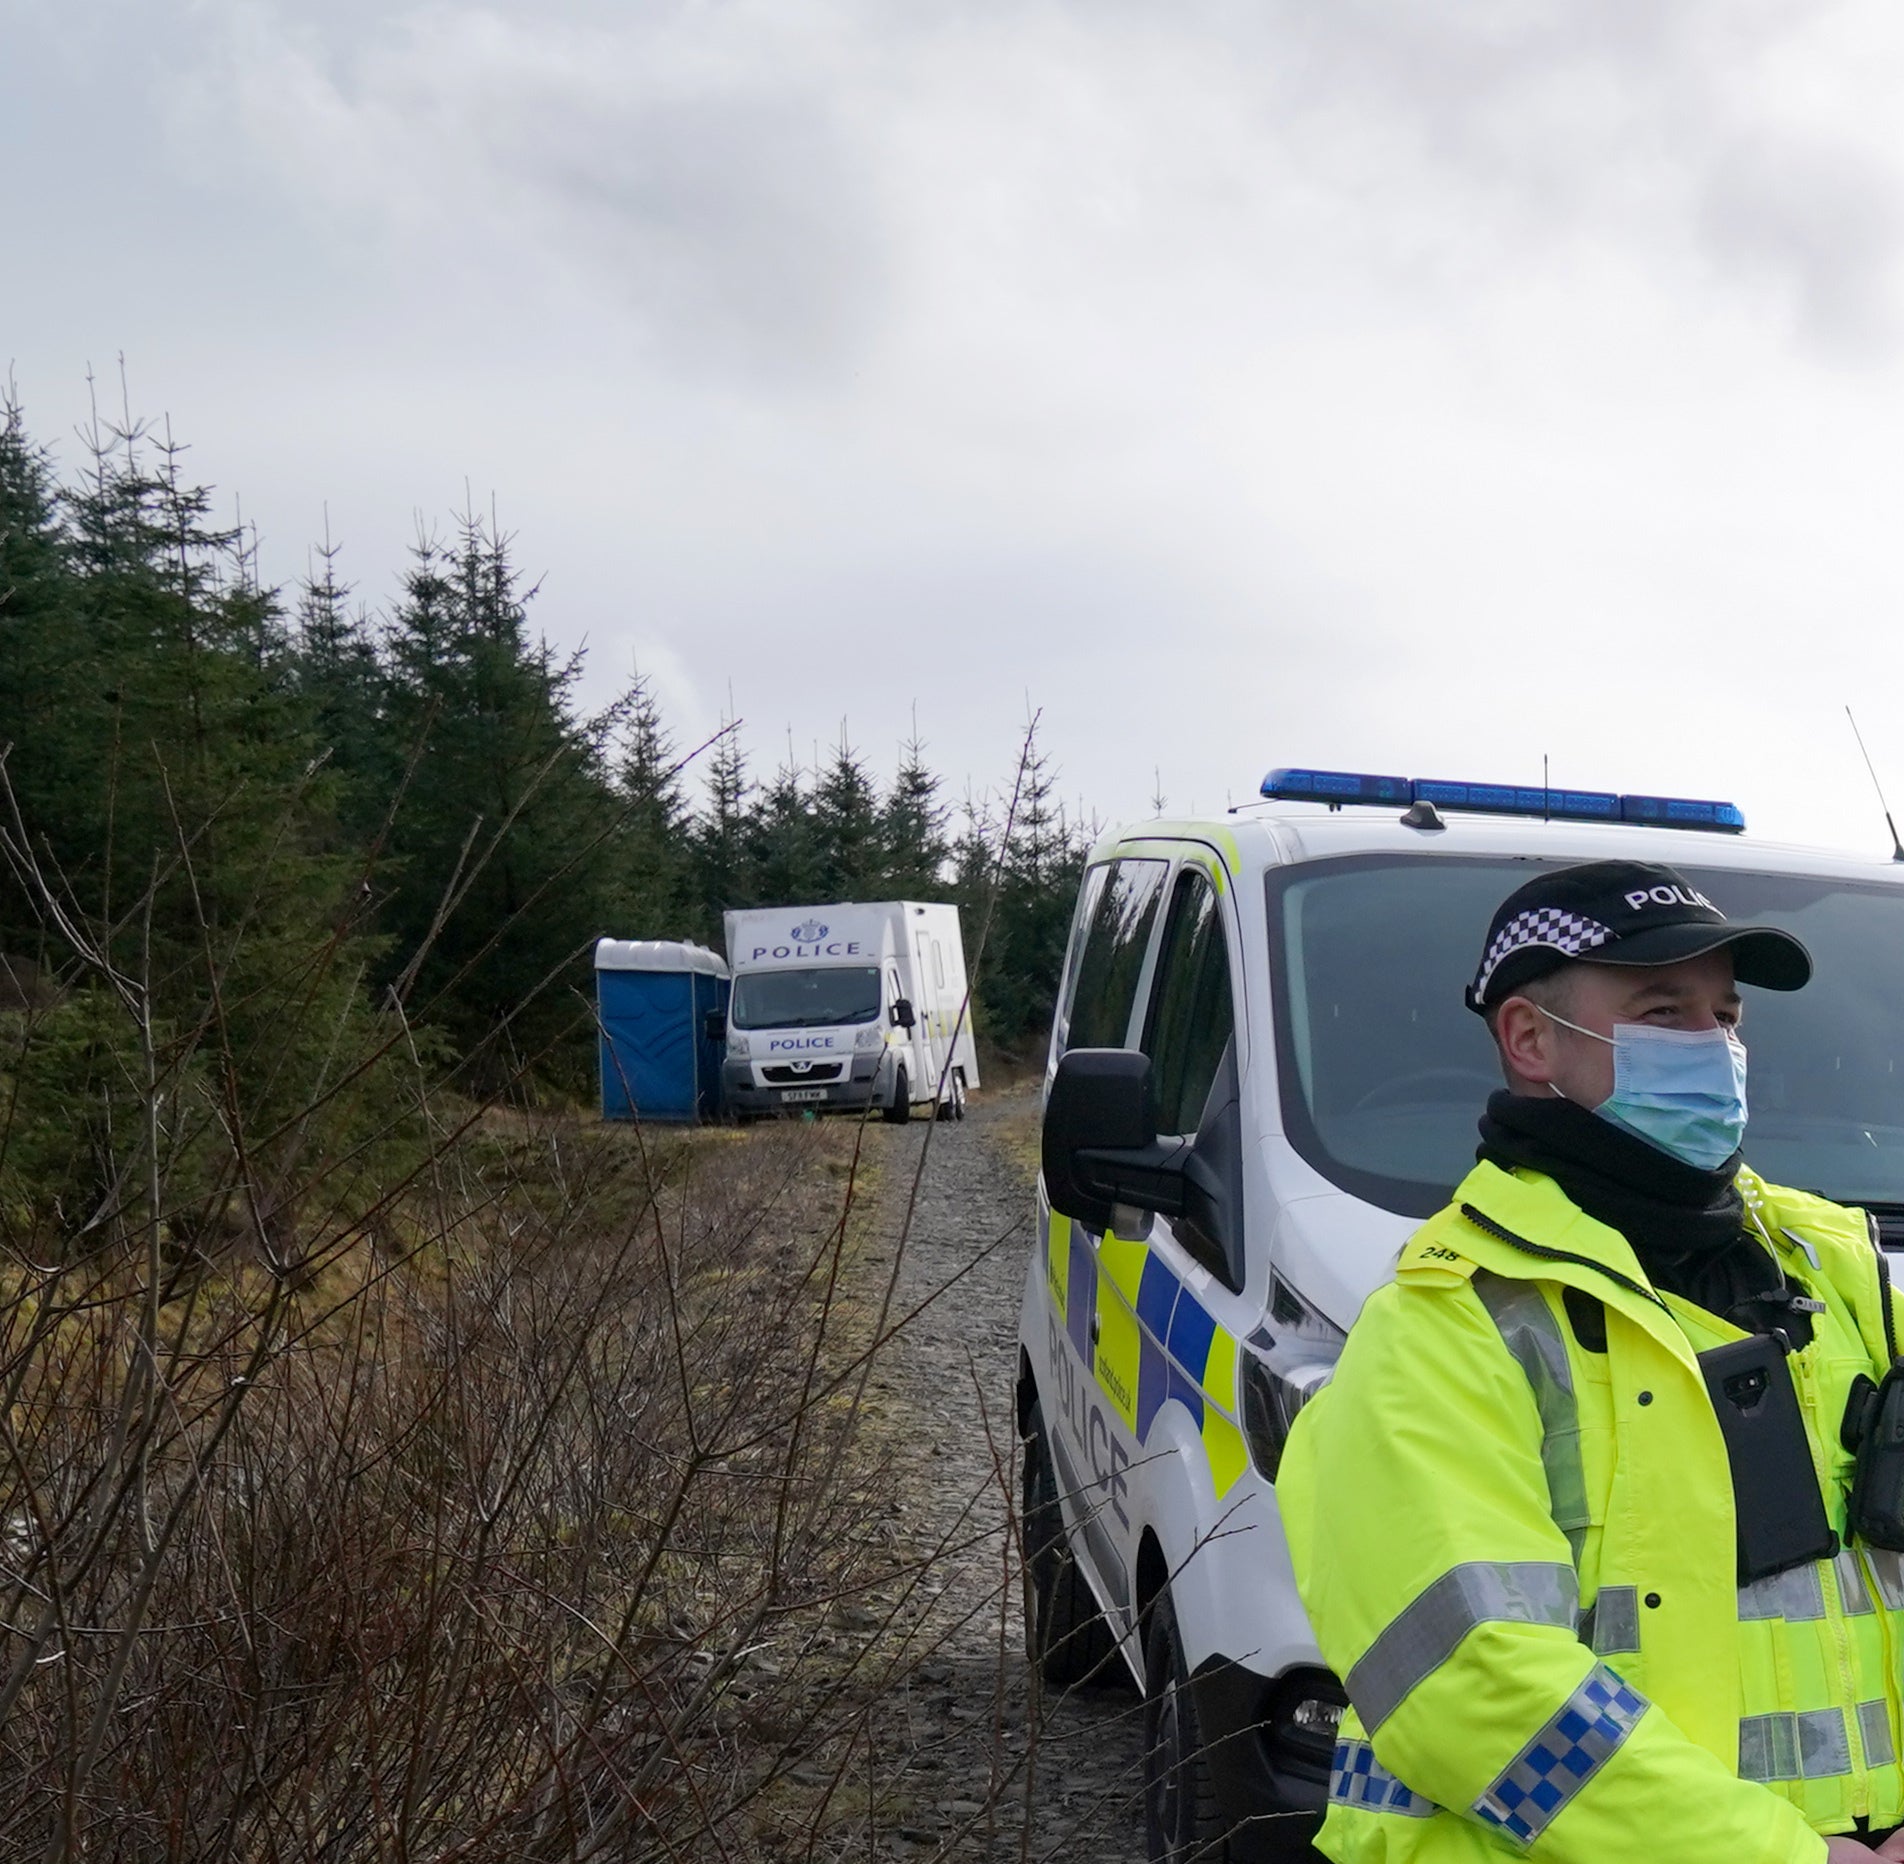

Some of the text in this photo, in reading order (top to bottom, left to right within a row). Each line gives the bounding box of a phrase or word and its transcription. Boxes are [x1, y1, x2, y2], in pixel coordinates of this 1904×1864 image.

[1624, 884, 1728, 921] POLIC
[752, 942, 861, 961] POLICE
[769, 1036, 835, 1051] POLICE
[1048, 1310, 1130, 1536] POLICE
